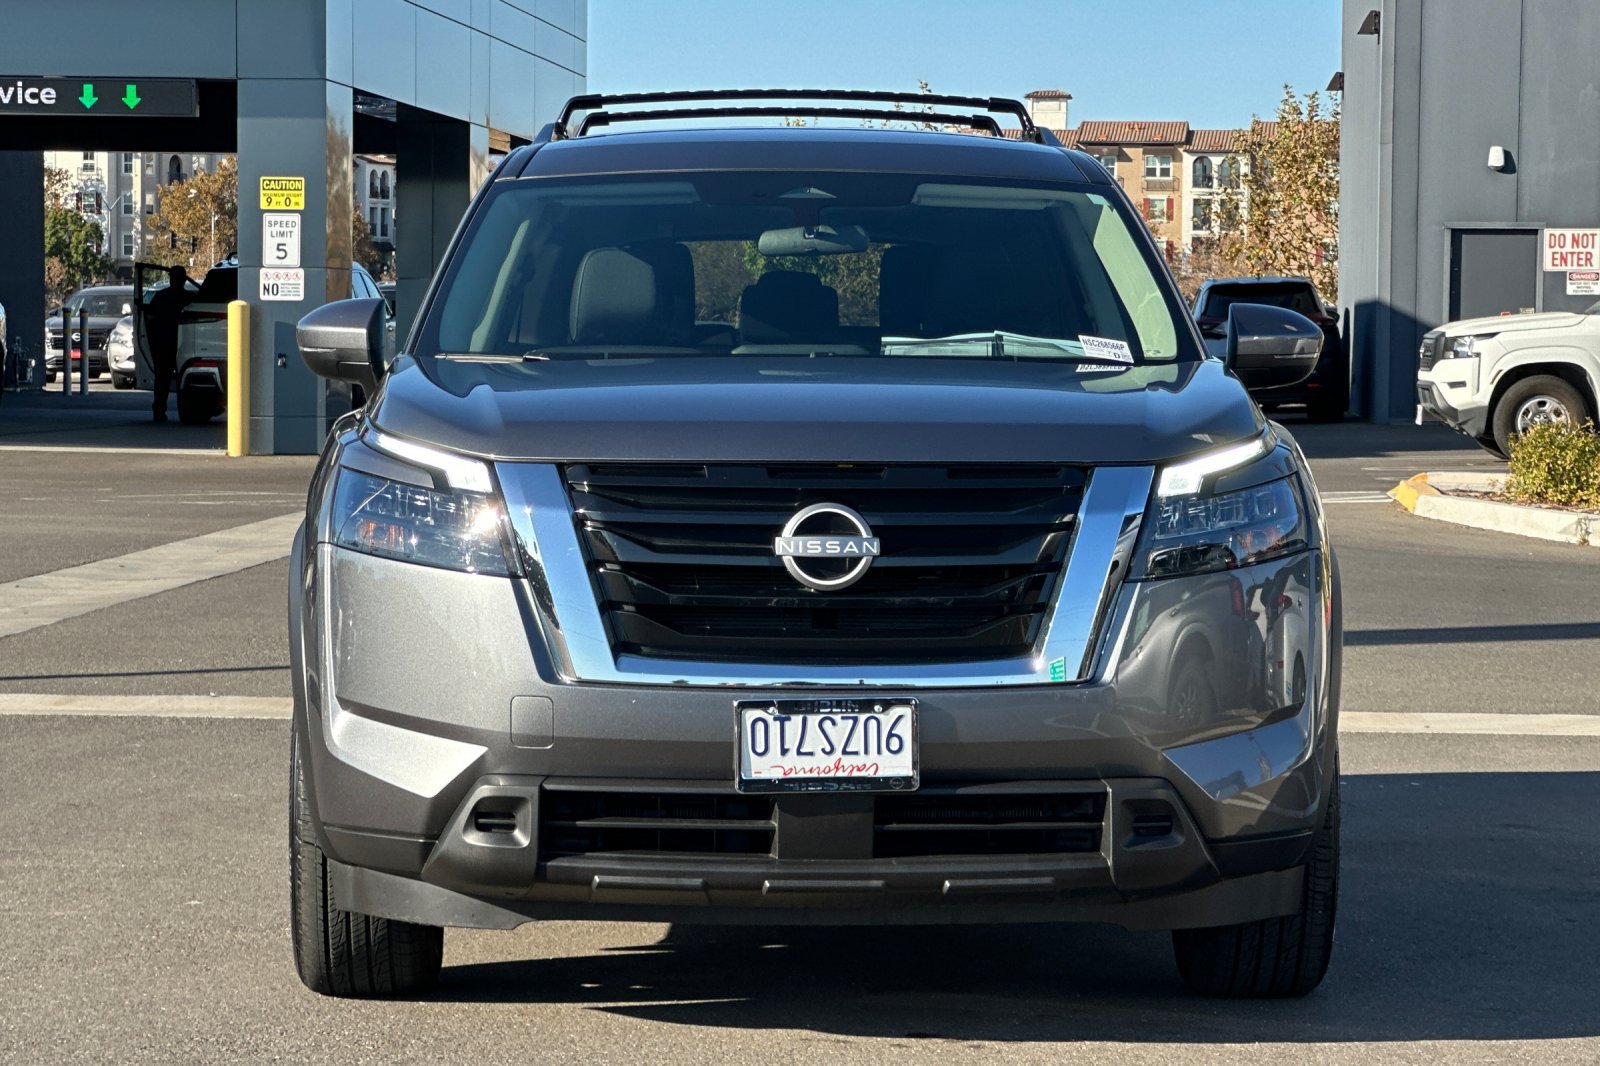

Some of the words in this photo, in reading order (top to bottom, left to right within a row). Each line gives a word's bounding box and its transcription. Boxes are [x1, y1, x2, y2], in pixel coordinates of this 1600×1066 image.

[0, 81, 57, 105] vice
[263, 180, 302, 190] CAUTION
[266, 196, 272, 207] 9
[284, 196, 291, 207] 0
[268, 220, 297, 228] SPEED
[270, 230, 294, 238] LIMIT
[1548, 233, 1566, 249] DO
[1571, 233, 1598, 249] NOT
[276, 243, 288, 260] 5
[1551, 251, 1594, 267] ENTER
[263, 282, 279, 296] NO
[779, 540, 878, 554] NISSAN
[750, 714, 904, 757] 9UZS710
